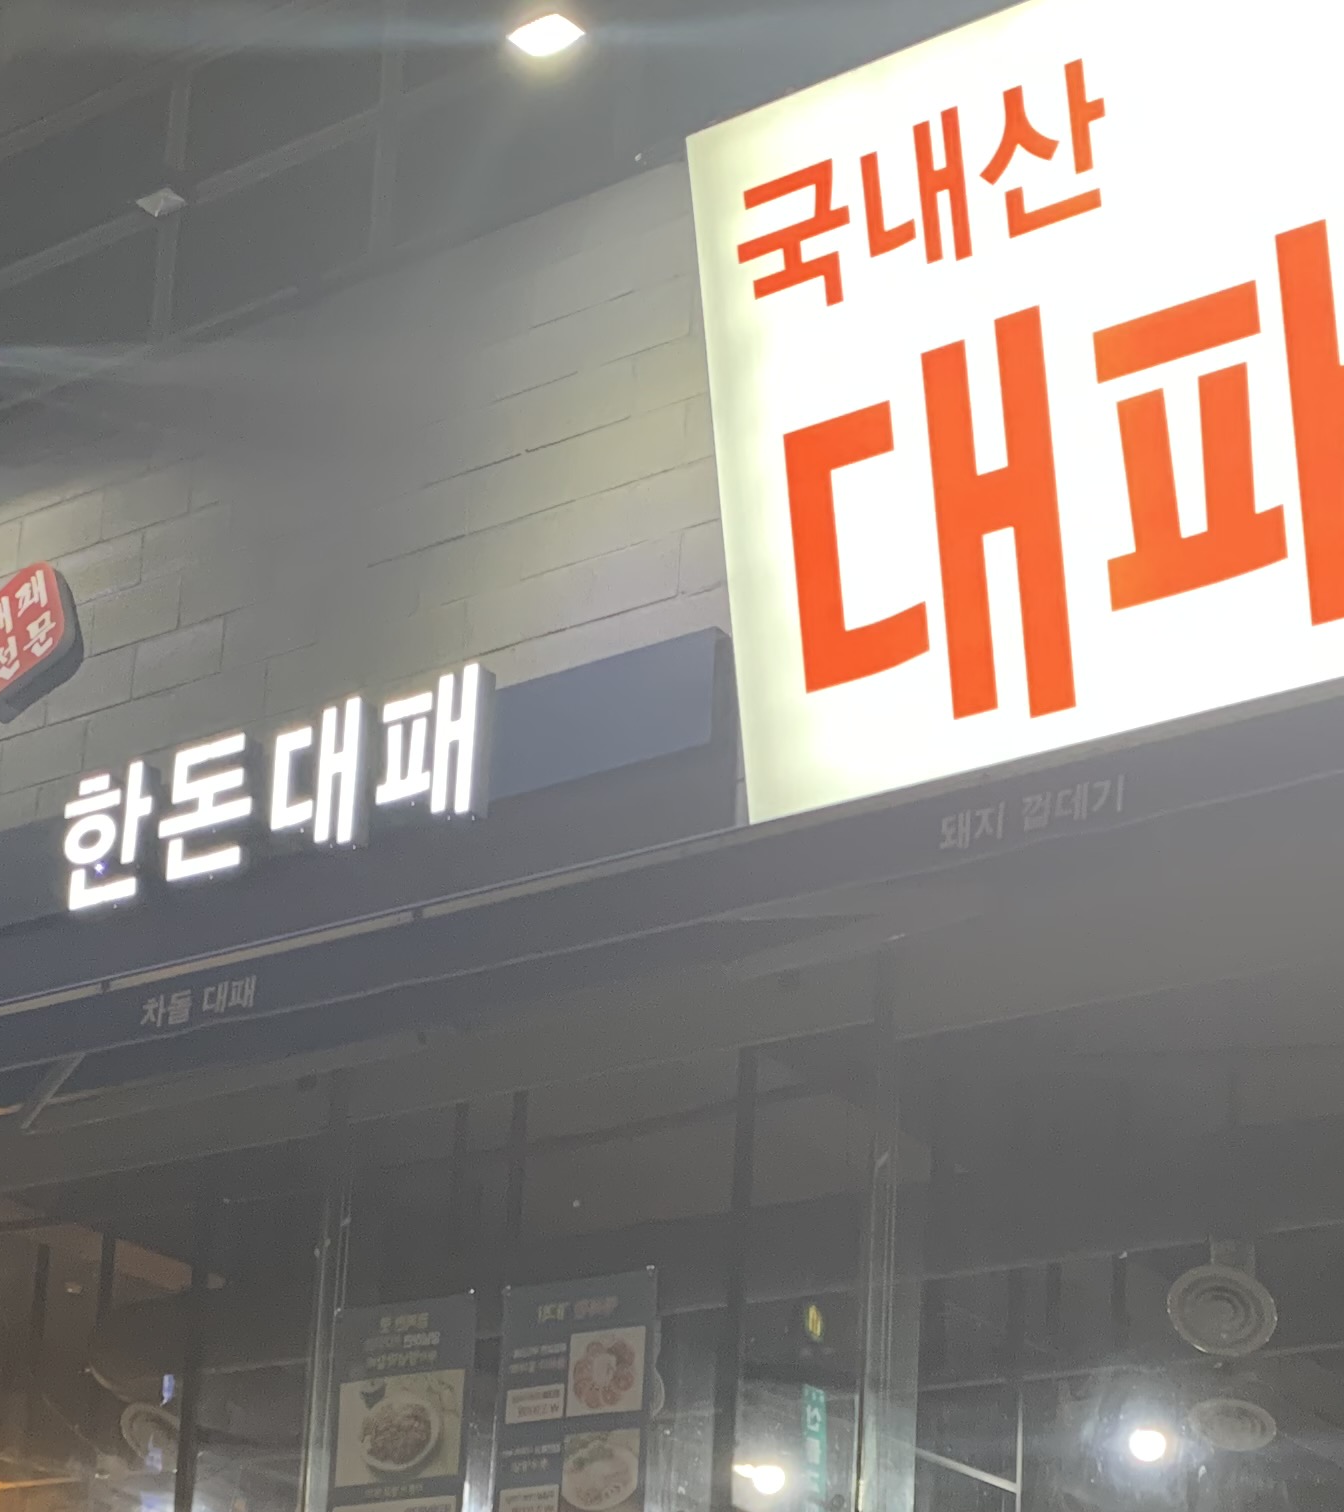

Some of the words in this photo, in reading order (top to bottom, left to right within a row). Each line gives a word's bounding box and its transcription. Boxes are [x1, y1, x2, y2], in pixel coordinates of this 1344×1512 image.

[738, 59, 1107, 308] 국내산
[63, 662, 481, 911] 한돈대패
[939, 801, 1005, 850] 돼지
[1022, 774, 1125, 832] 껍데기
[140, 986, 192, 1028] 차돌
[202, 975, 257, 1014] 대패
